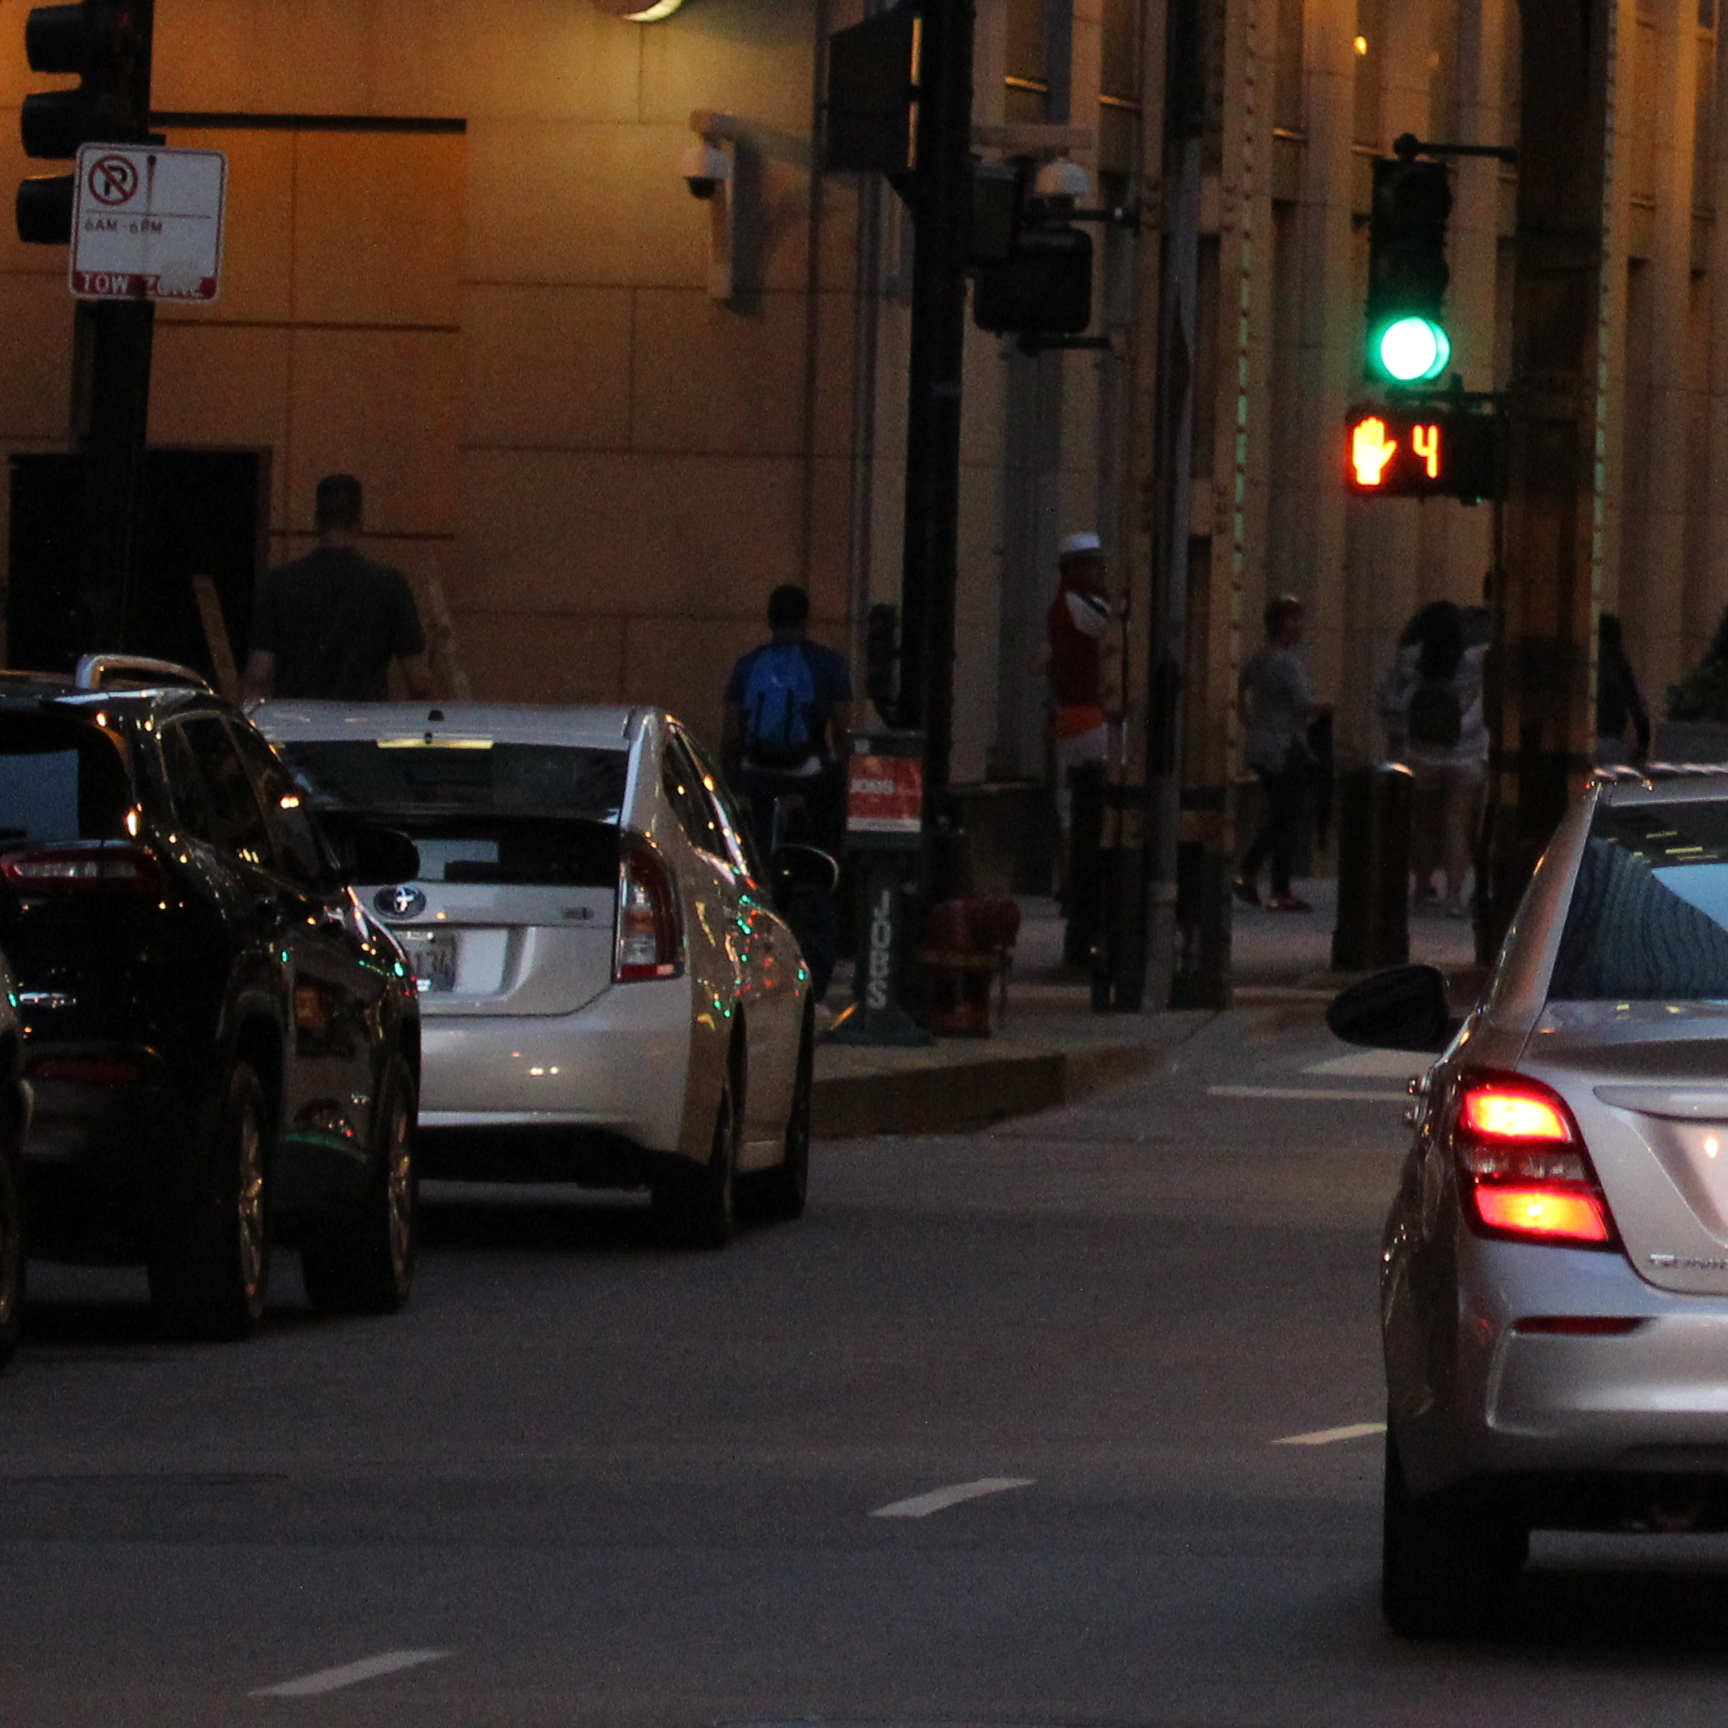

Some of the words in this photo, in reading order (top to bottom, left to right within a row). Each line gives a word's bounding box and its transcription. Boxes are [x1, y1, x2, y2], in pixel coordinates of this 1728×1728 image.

[82, 274, 129, 295] TOW
[1413, 424, 1438, 480] 4
[866, 889, 891, 1009] JOBS
